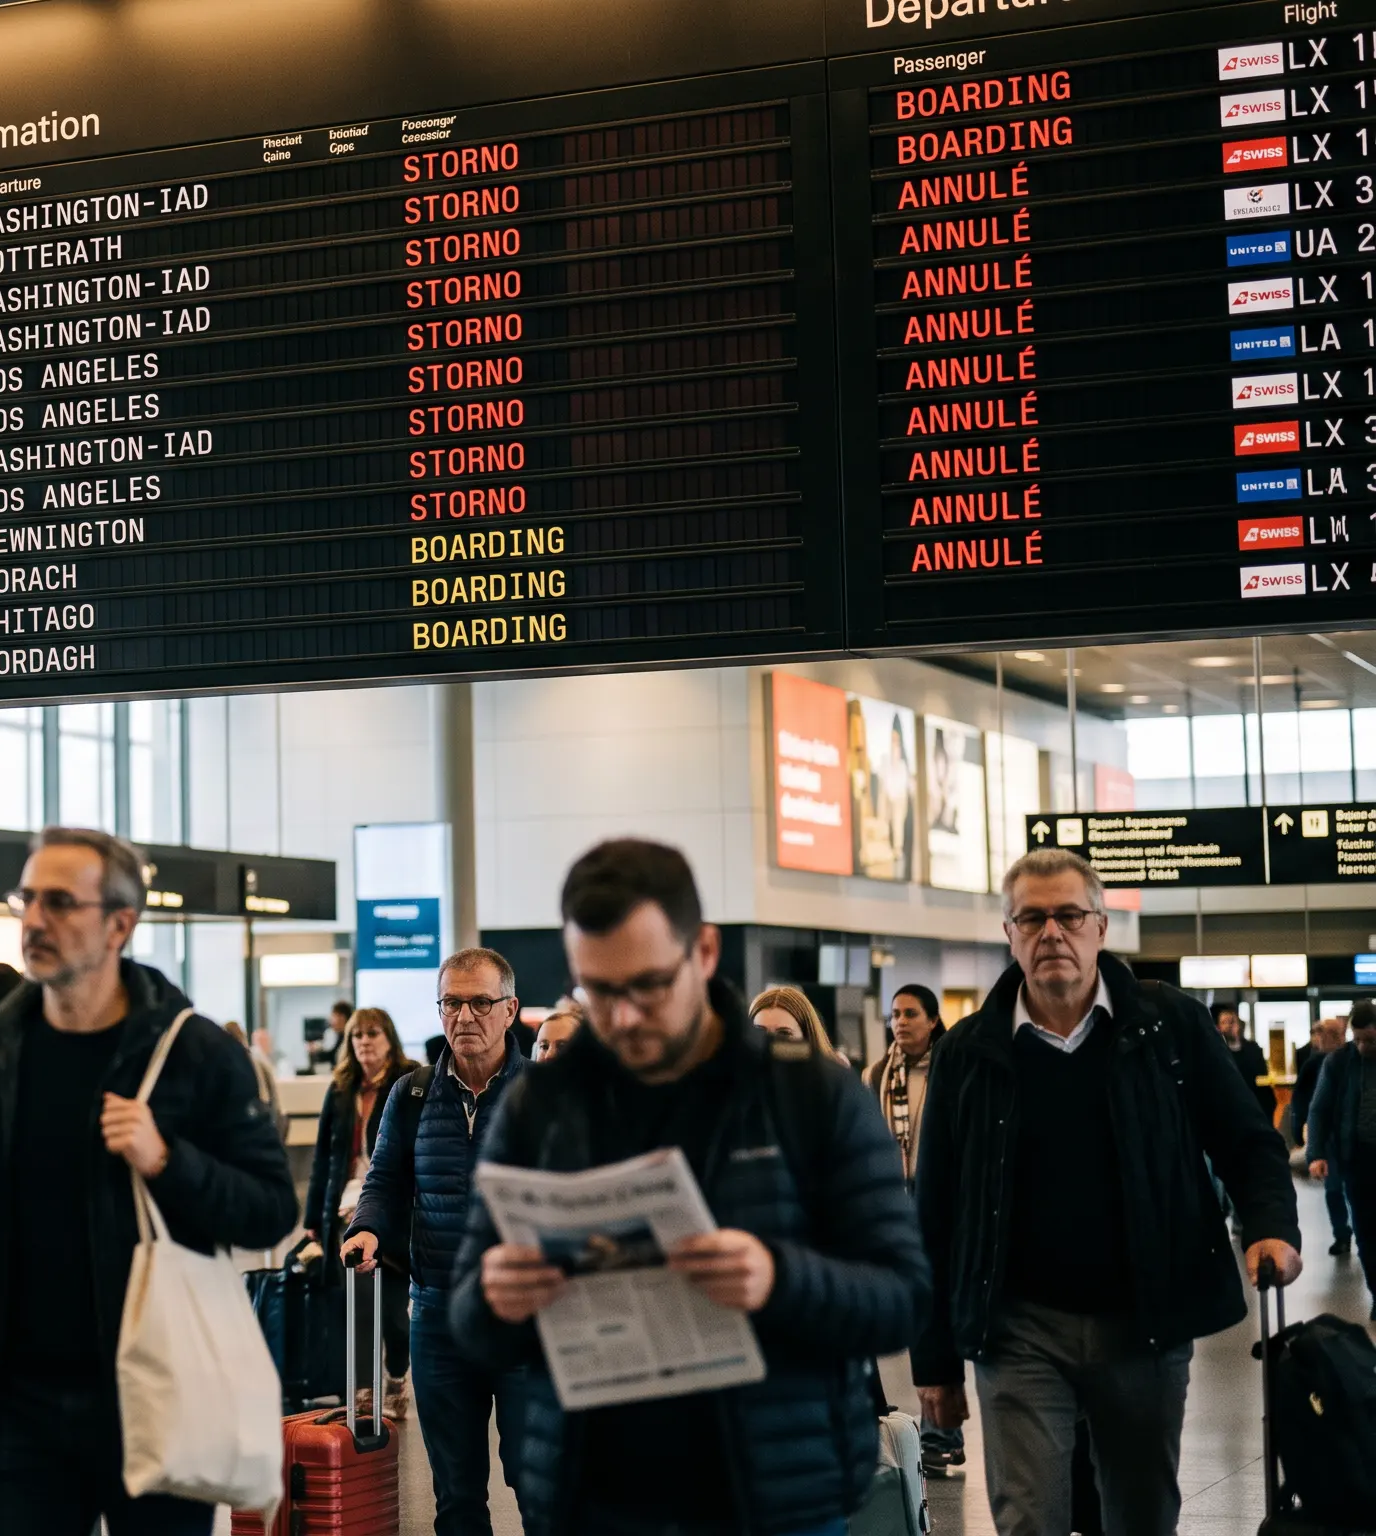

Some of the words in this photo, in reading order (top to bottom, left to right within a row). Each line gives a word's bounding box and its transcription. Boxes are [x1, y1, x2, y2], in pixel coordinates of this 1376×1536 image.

[1285, 1, 1337, 24] Flight
[894, 51, 986, 74] Passenger
[1240, 54, 1280, 67] SWISS
[1289, 38, 1328, 69] LX
[897, 72, 1070, 119] BOARDING
[1242, 102, 1281, 114] SWISS
[1291, 86, 1330, 116] LX
[898, 117, 1072, 164] BOARDING
[1243, 147, 1282, 160] SWISS
[1293, 133, 1332, 163] LX
[404, 144, 518, 182] STORNO
[899, 162, 1028, 209] ANNULÉ
[1295, 180, 1334, 210] LX
[405, 186, 518, 223] STORNO
[900, 208, 1030, 254] ANNULÉ
[1296, 228, 1337, 257] UA
[407, 271, 520, 308] STORNO
[903, 254, 1032, 299] ANNULÉ
[1250, 289, 1291, 301] SWISS
[1299, 276, 1339, 305] LX
[904, 299, 1034, 344] ANNULÉ
[1235, 340, 1277, 350] UNITED
[1301, 324, 1341, 352] LA
[41, 353, 158, 388] ANGELES
[408, 314, 521, 350] STORNO
[906, 346, 1036, 390] ANNULÉ
[42, 394, 159, 428] ANGELES
[409, 357, 522, 392] STORNO
[1254, 384, 1295, 396] SWISS
[1303, 371, 1342, 400] LX
[410, 400, 523, 435] STORNO
[907, 391, 1038, 435] ANNULÉ
[1256, 431, 1295, 443] SWISS
[1306, 419, 1345, 447] LX
[43, 476, 160, 509] ANGELES
[410, 443, 524, 478] STORNO
[909, 438, 1040, 480] ANNULÉ
[411, 486, 525, 520] STORNO
[911, 484, 1041, 526] ANNULÉ
[412, 527, 563, 563] BOARDING
[912, 530, 1042, 571] ANNULÉ
[413, 570, 564, 606] BOARDING
[1261, 576, 1302, 587] SWISS
[1312, 562, 1350, 591] LX
[414, 614, 566, 649] BOARDING
